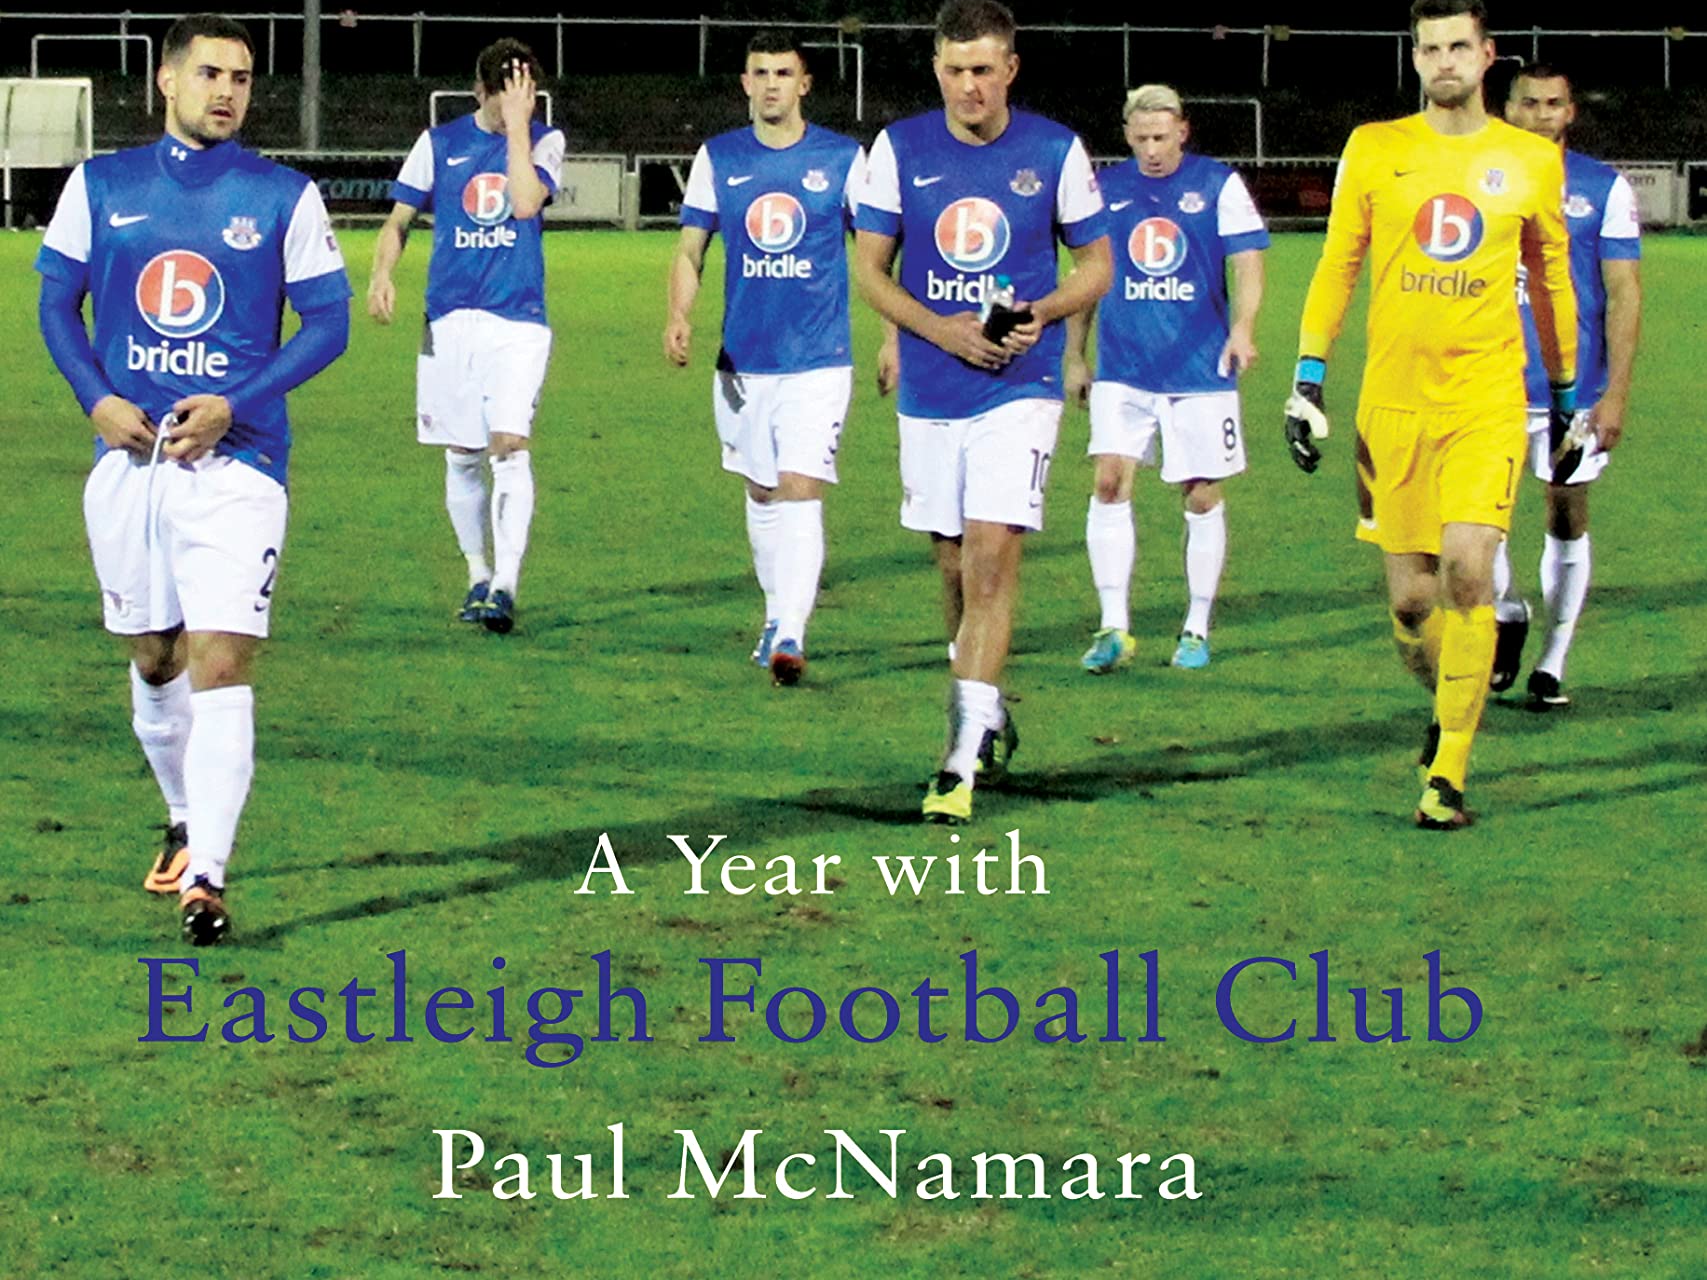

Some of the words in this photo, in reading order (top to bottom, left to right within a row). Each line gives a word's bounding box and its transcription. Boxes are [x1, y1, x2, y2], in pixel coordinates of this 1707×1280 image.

[455, 226, 517, 248] bridle
[761, 201, 793, 245] b
[954, 207, 993, 262] b
[1428, 198, 1471, 256] b
[742, 253, 812, 278] bridle
[1144, 225, 1175, 268] b
[158, 260, 206, 326] b
[927, 270, 995, 303] bridl
[1125, 276, 1194, 301] bridle
[1401, 264, 1487, 297] bridle
[127, 334, 229, 377] bridle
[1222, 416, 1236, 450] 8
[1031, 448, 1052, 494] 10
[1506, 456, 1514, 499] 1
[260, 547, 277, 598] 2
